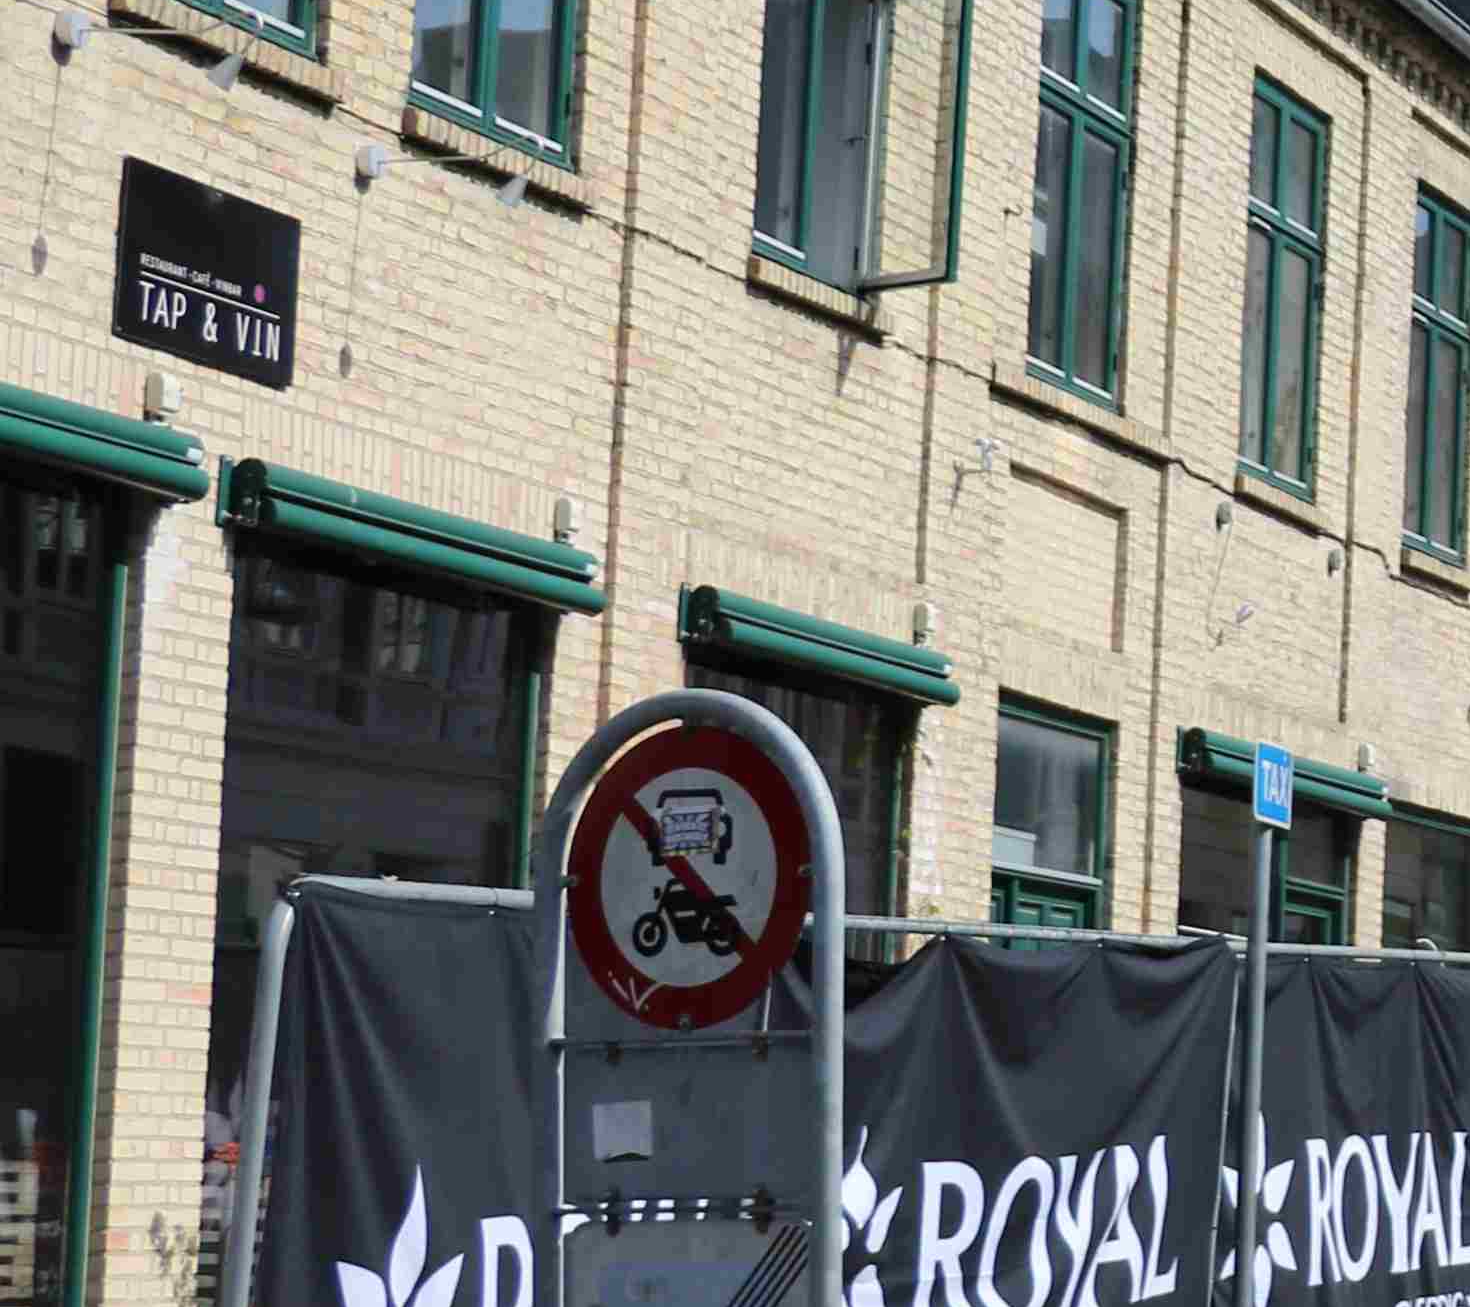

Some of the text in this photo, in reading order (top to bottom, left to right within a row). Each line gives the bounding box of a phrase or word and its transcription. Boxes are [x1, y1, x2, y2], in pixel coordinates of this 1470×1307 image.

[138, 280, 281, 362] TAP & VIN
